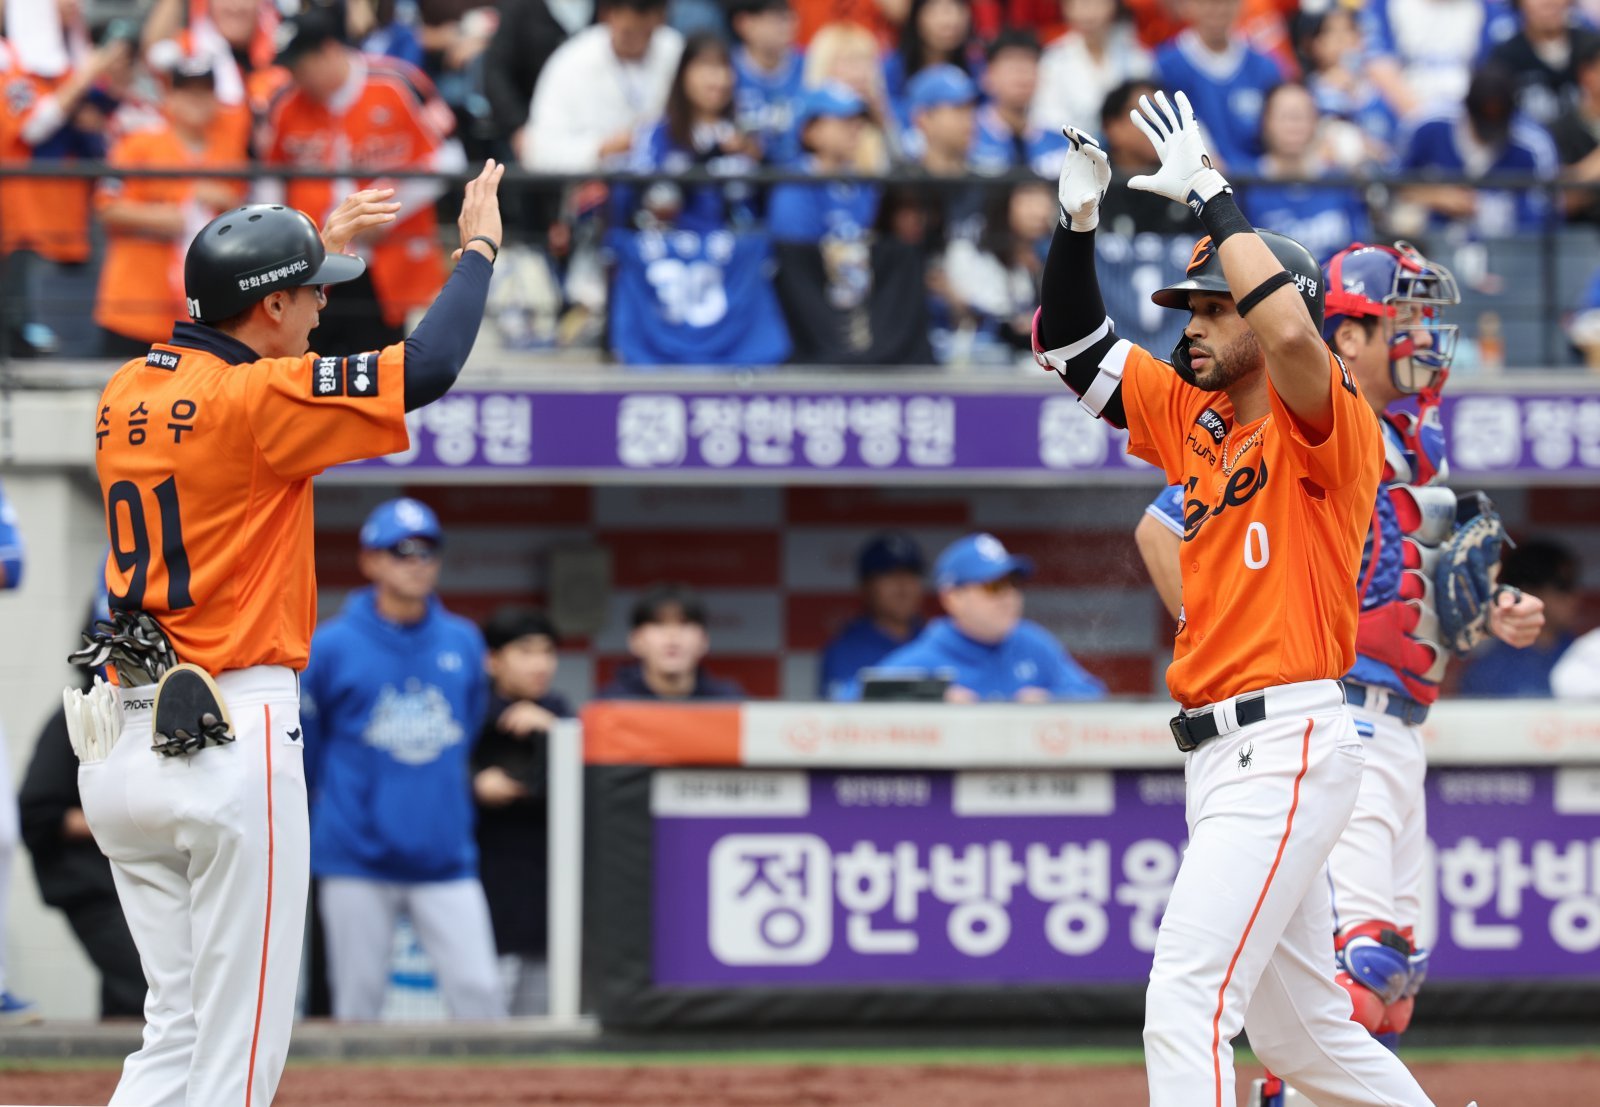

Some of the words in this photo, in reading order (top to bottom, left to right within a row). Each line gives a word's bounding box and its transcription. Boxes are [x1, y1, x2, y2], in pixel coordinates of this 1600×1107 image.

[187, 297, 201, 318] 91
[108, 475, 195, 611] 91
[1244, 521, 1270, 569] 0
